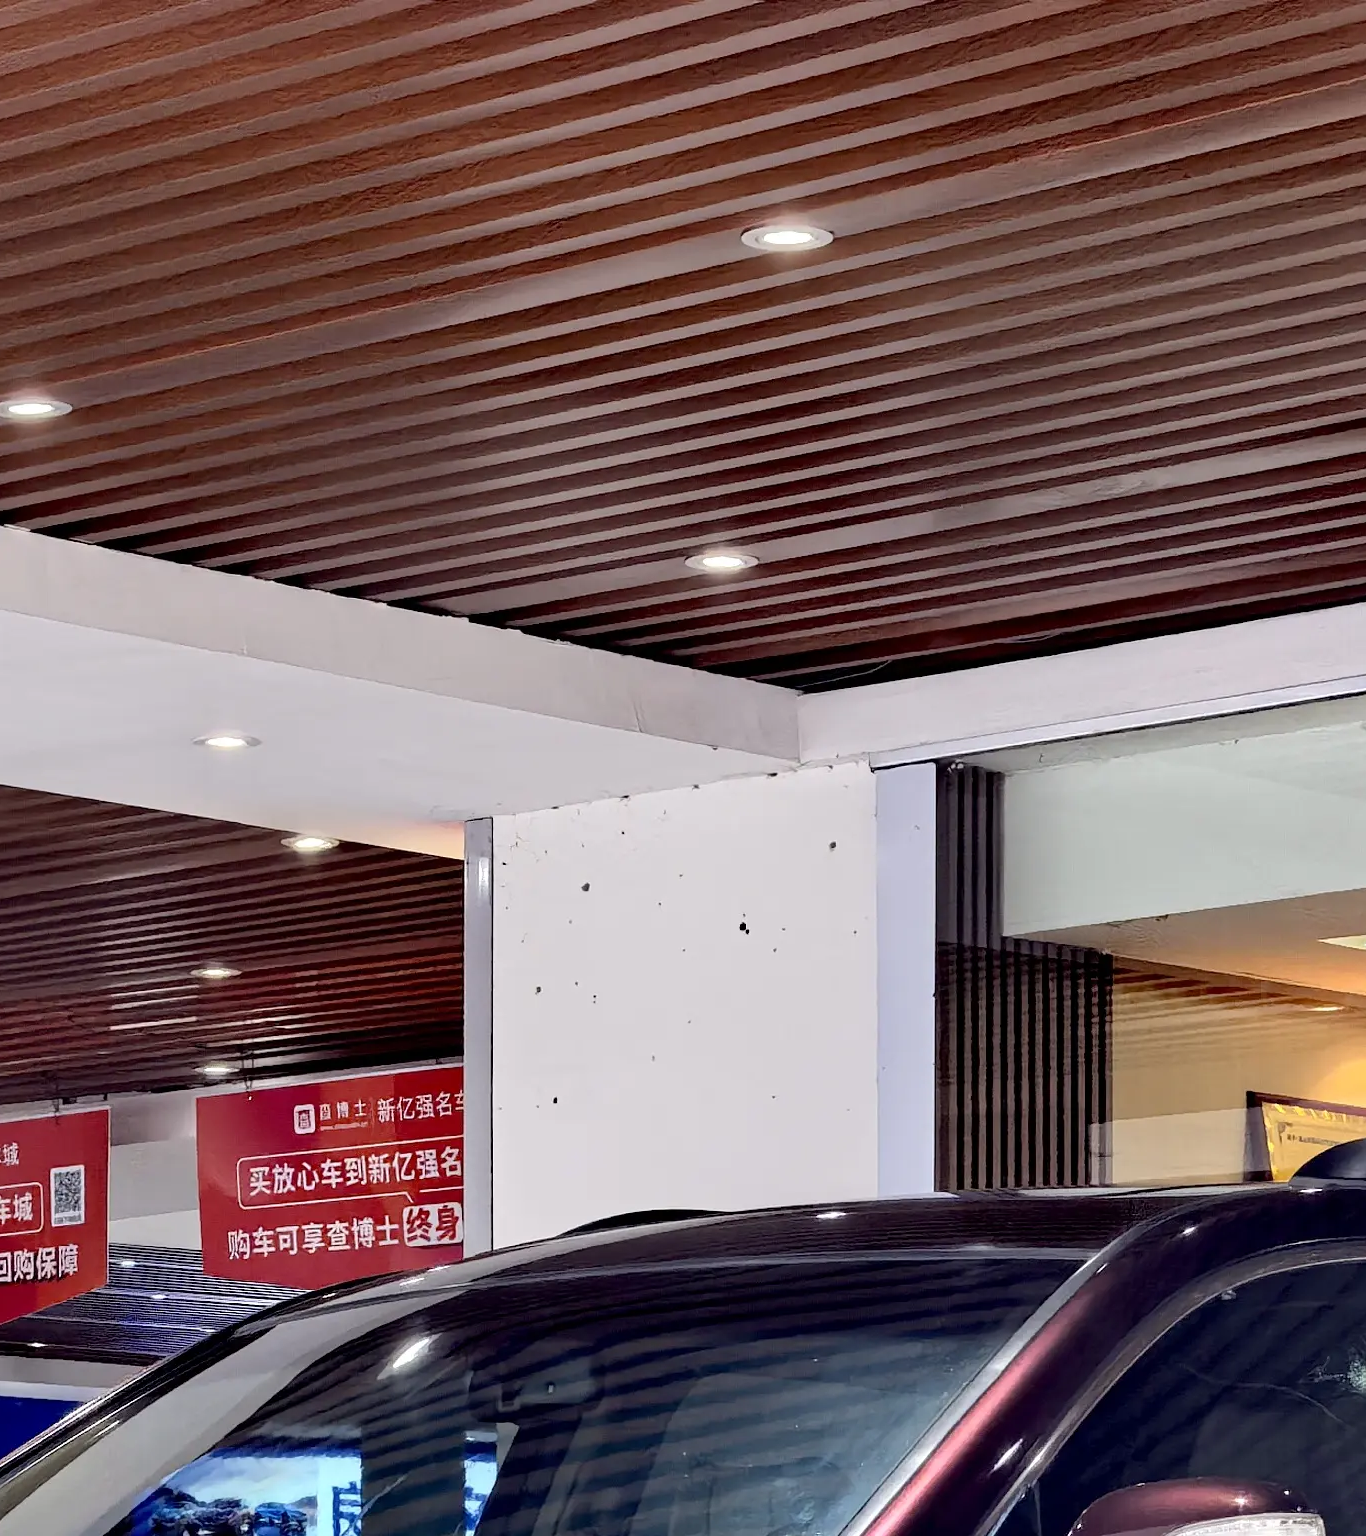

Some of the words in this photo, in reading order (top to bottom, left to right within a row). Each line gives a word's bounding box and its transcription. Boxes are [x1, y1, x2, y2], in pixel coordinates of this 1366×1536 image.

[248, 1145, 463, 1198] 买放心车到新亿强名
[226, 1204, 461, 1261] 购车可享查博士终身
